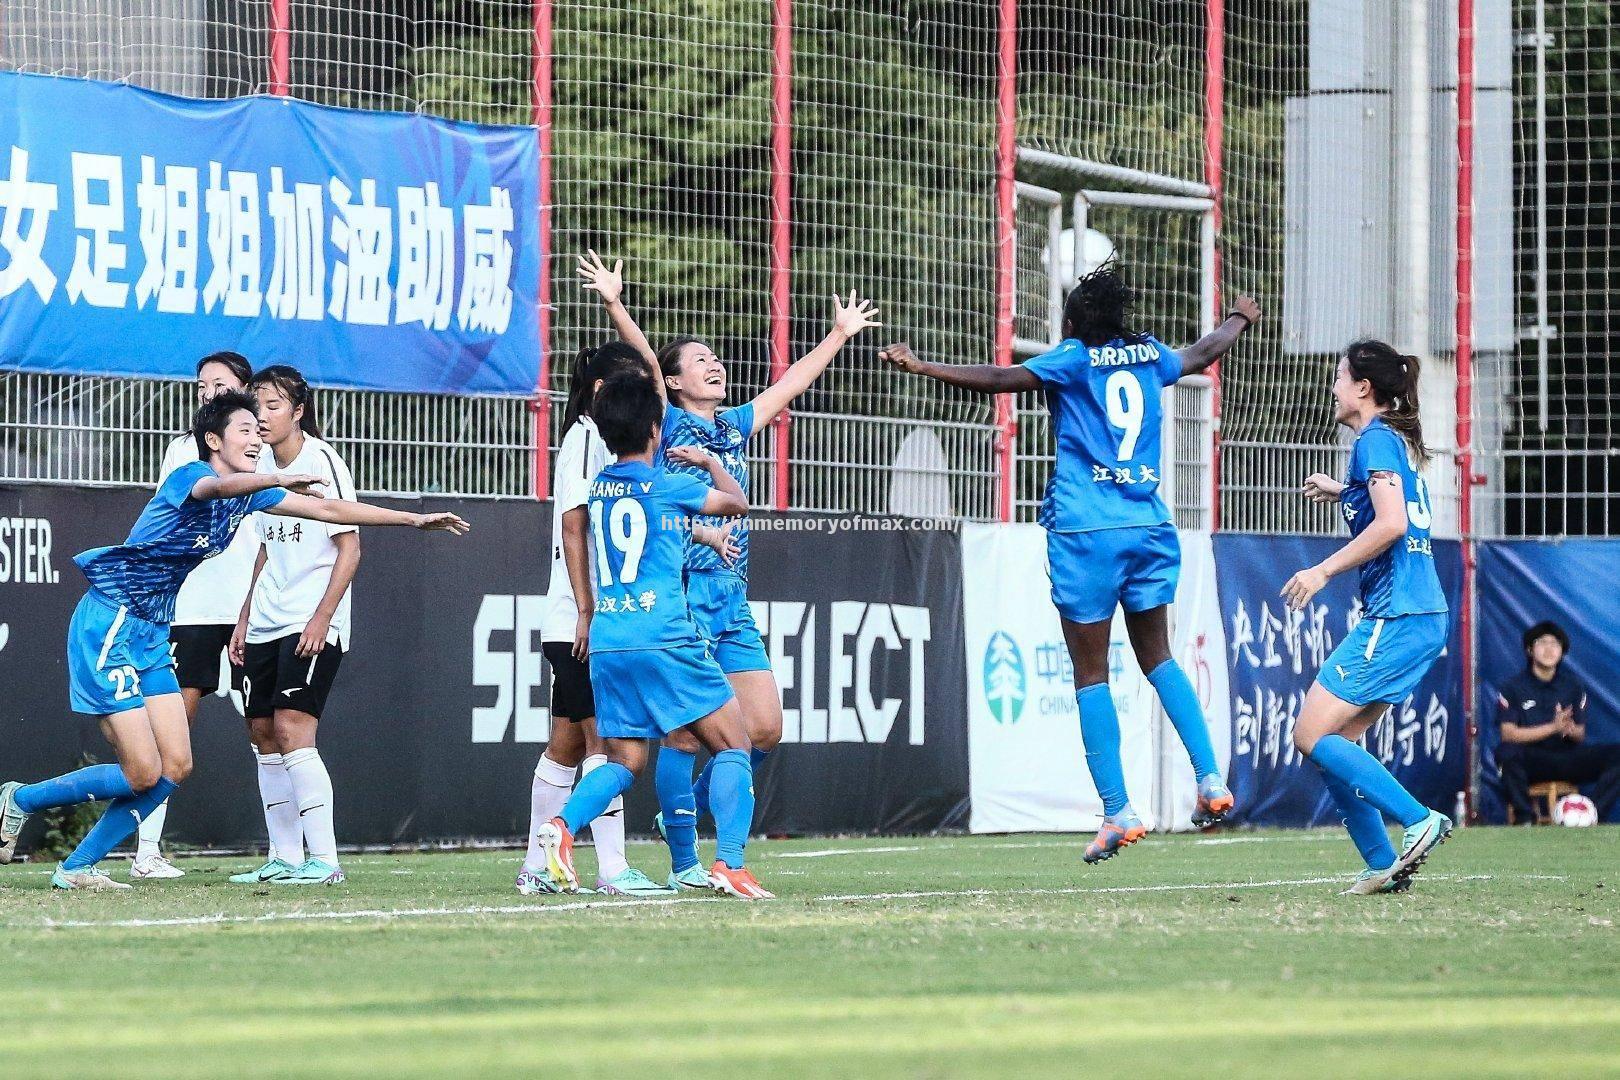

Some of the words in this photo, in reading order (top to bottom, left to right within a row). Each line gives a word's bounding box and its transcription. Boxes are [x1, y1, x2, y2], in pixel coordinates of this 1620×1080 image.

[0, 145, 514, 334] 女足姐姐加油助威
[1105, 369, 1145, 462] 9
[0, 516, 60, 584] STER.
[589, 497, 648, 588] 19
